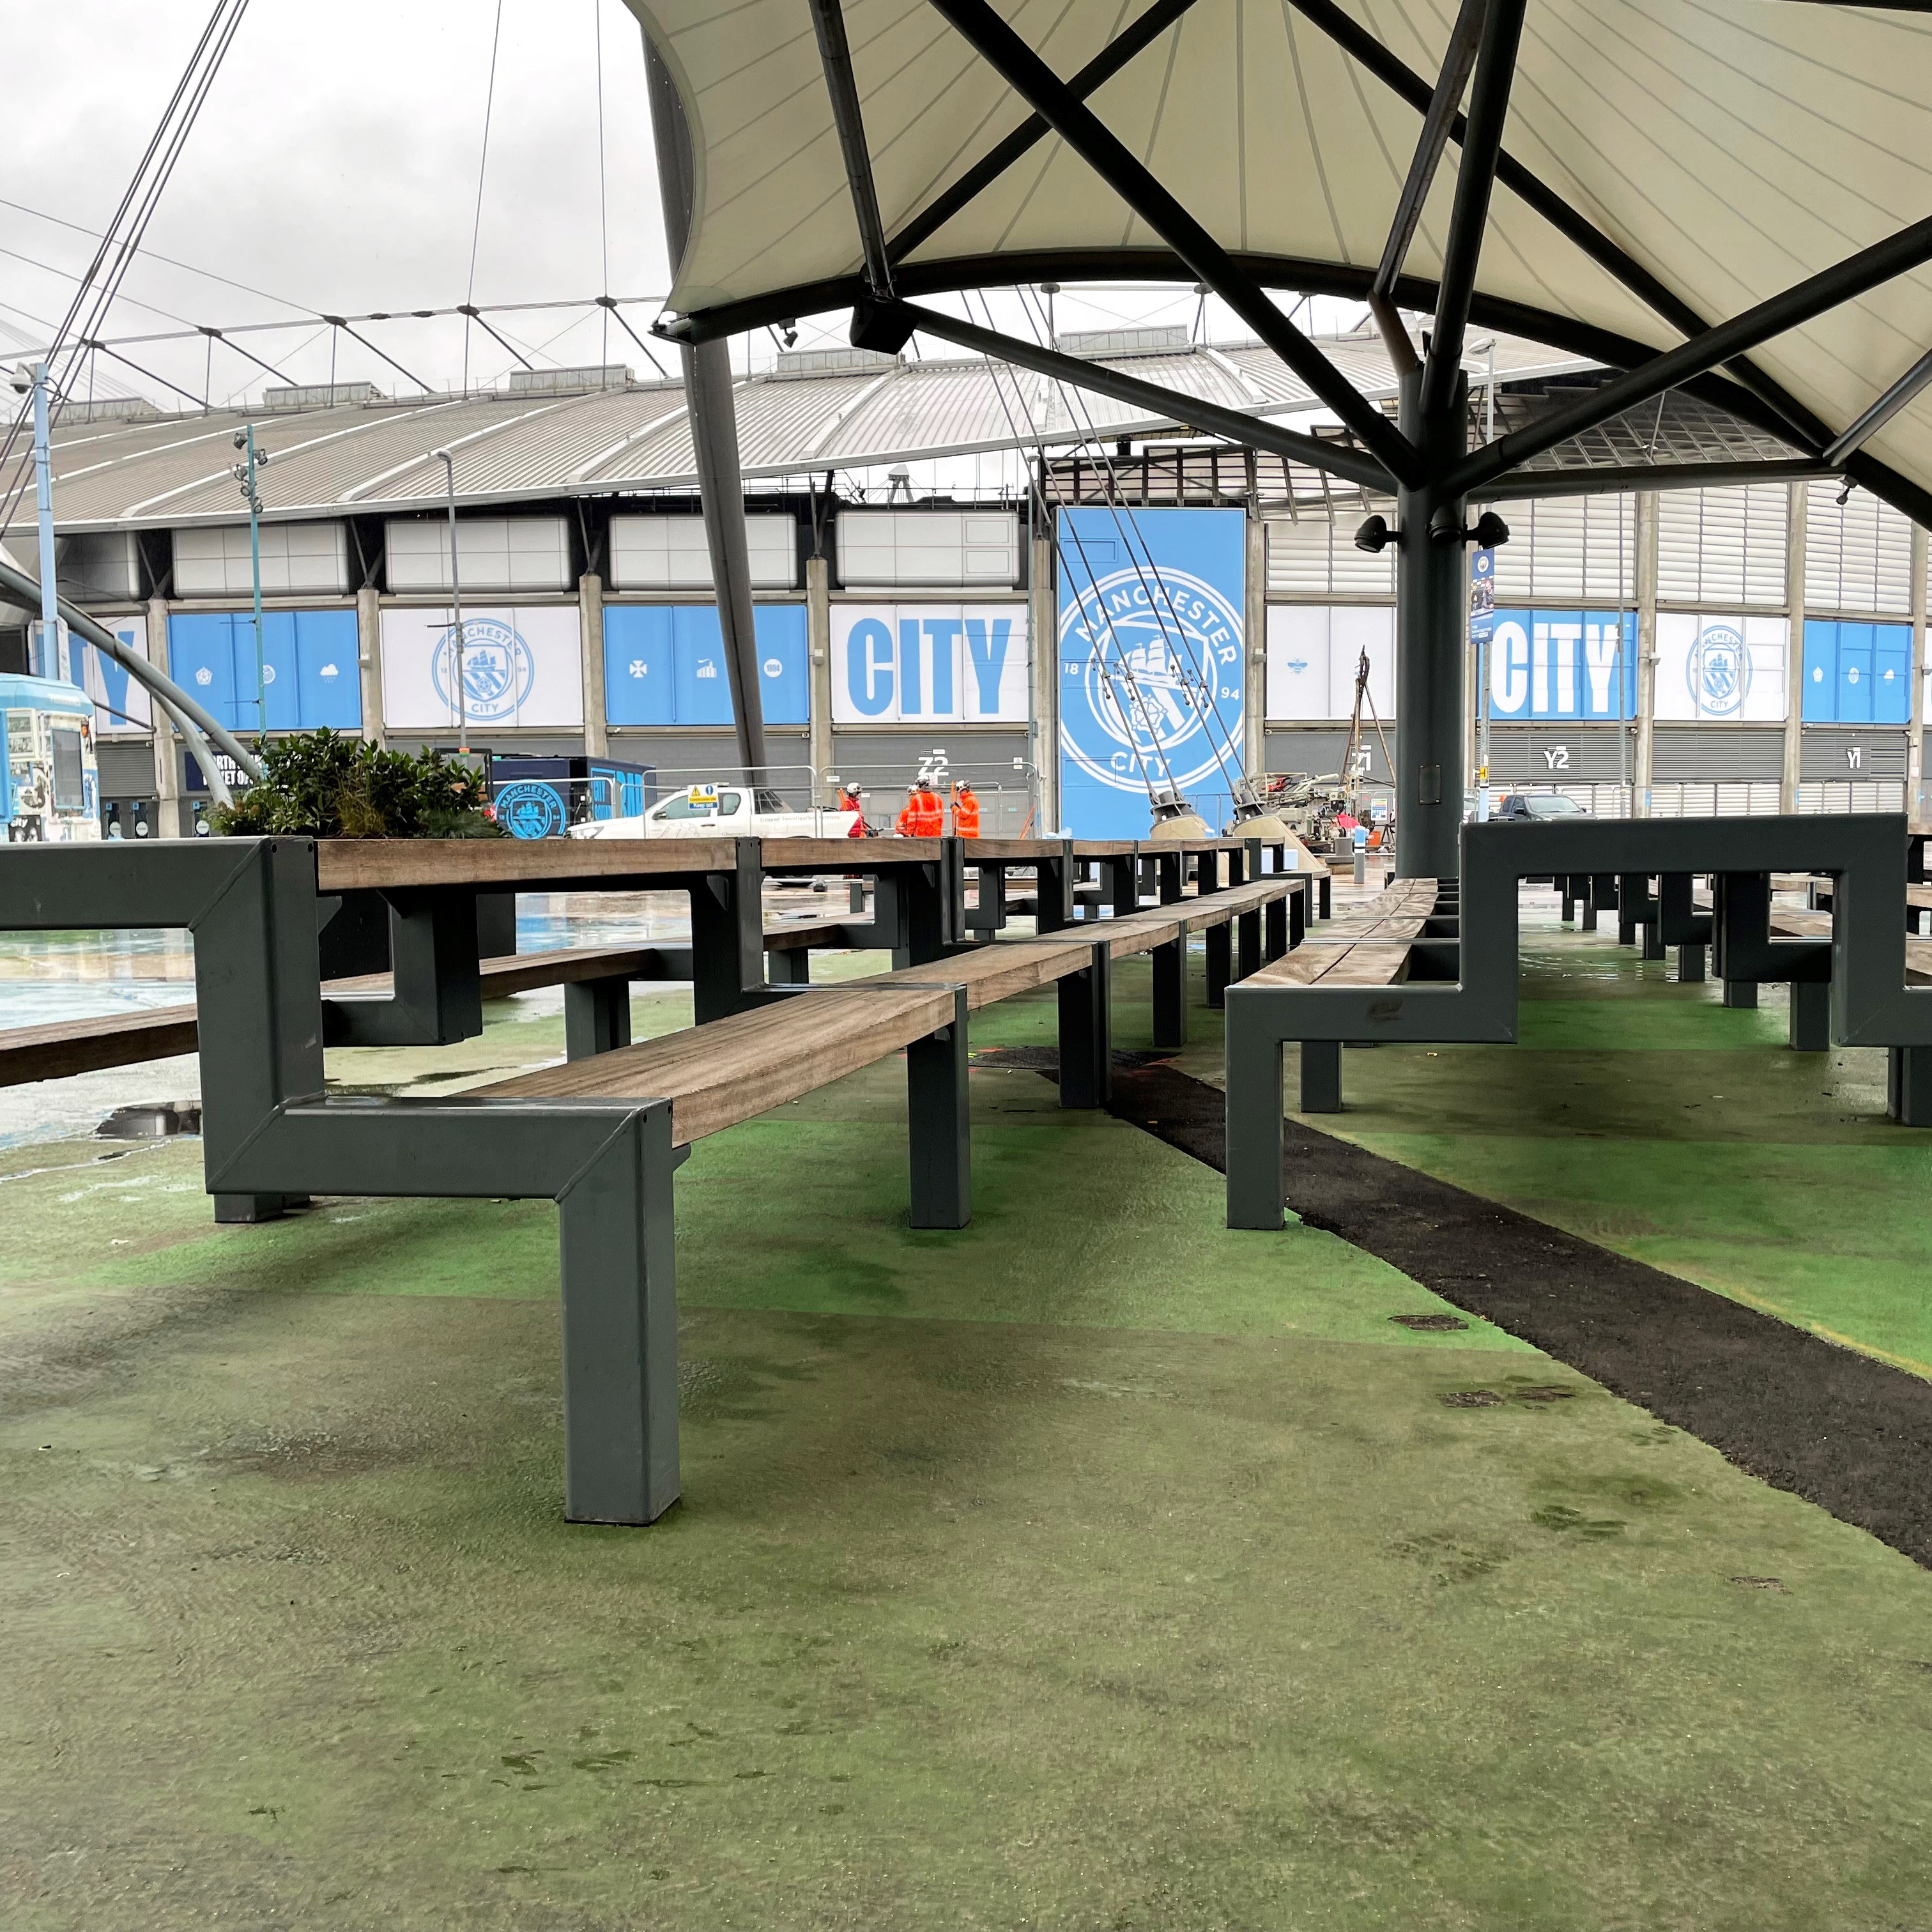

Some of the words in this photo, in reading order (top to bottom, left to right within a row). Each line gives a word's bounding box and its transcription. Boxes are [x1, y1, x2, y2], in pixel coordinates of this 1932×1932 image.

[1075, 585, 1238, 665] MANCHESTER
[847, 618, 1012, 716] CITY
[1064, 663, 1079, 675] 18
[1491, 621, 1618, 713] CITY
[1221, 687, 1240, 700] 94
[471, 703, 499, 712] CITY
[1710, 700, 1729, 709] CITY
[918, 756, 949, 776] Z2
[1110, 751, 1172, 778] CITY
[1544, 750, 1570, 769] Y2
[1847, 751, 1860, 769] Y1
[500, 785, 557, 809] MANCHESTER
